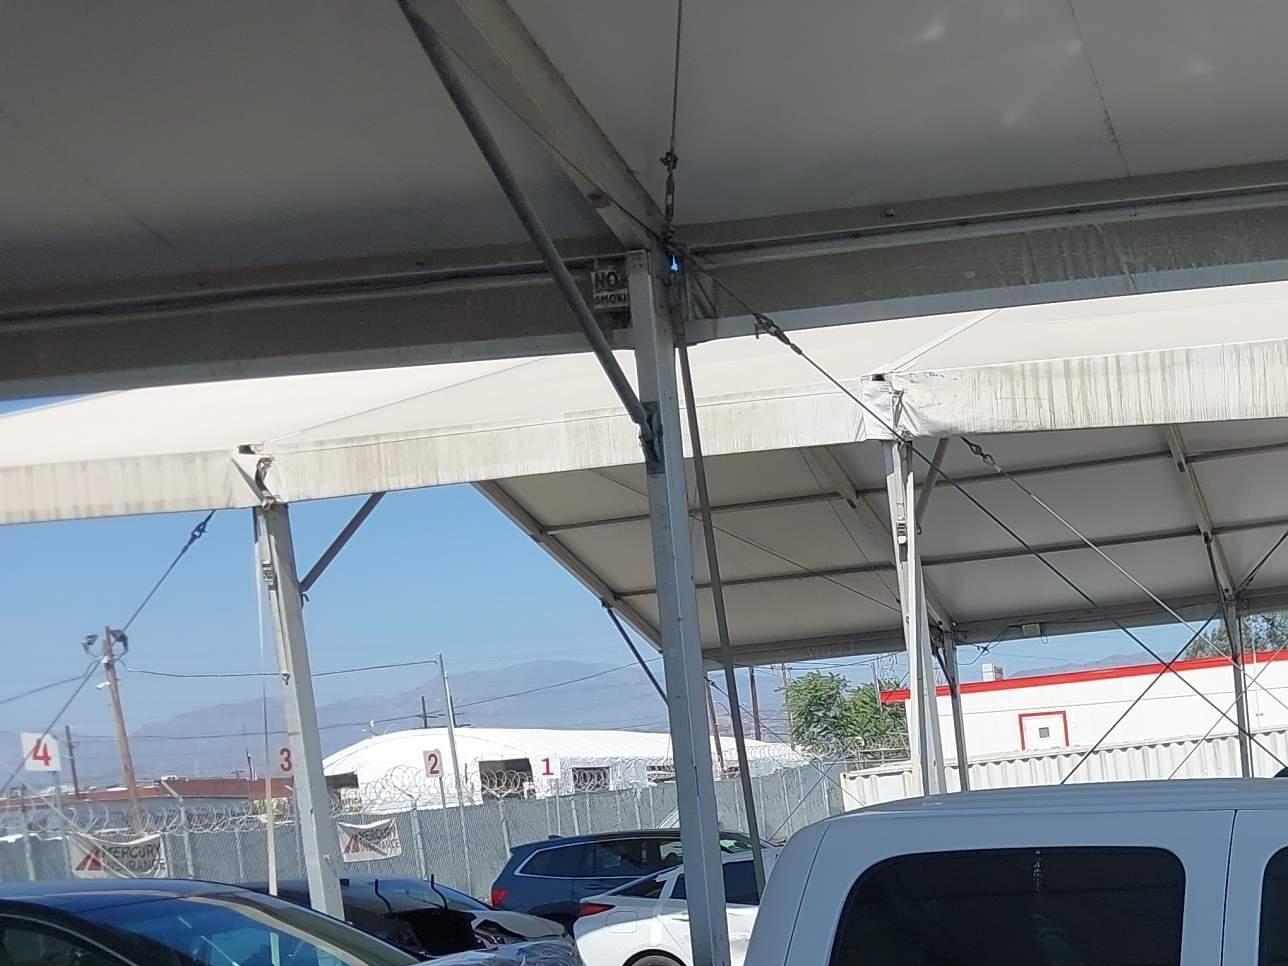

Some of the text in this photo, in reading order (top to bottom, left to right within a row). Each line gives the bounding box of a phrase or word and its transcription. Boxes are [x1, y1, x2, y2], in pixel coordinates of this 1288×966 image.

[595, 272, 618, 289] NO
[594, 293, 628, 305] SMOKI
[32, 738, 52, 766] 4
[279, 747, 292, 772] 3
[427, 753, 440, 775] 2
[541, 757, 554, 776] 1
[103, 843, 161, 859] MERCURY
